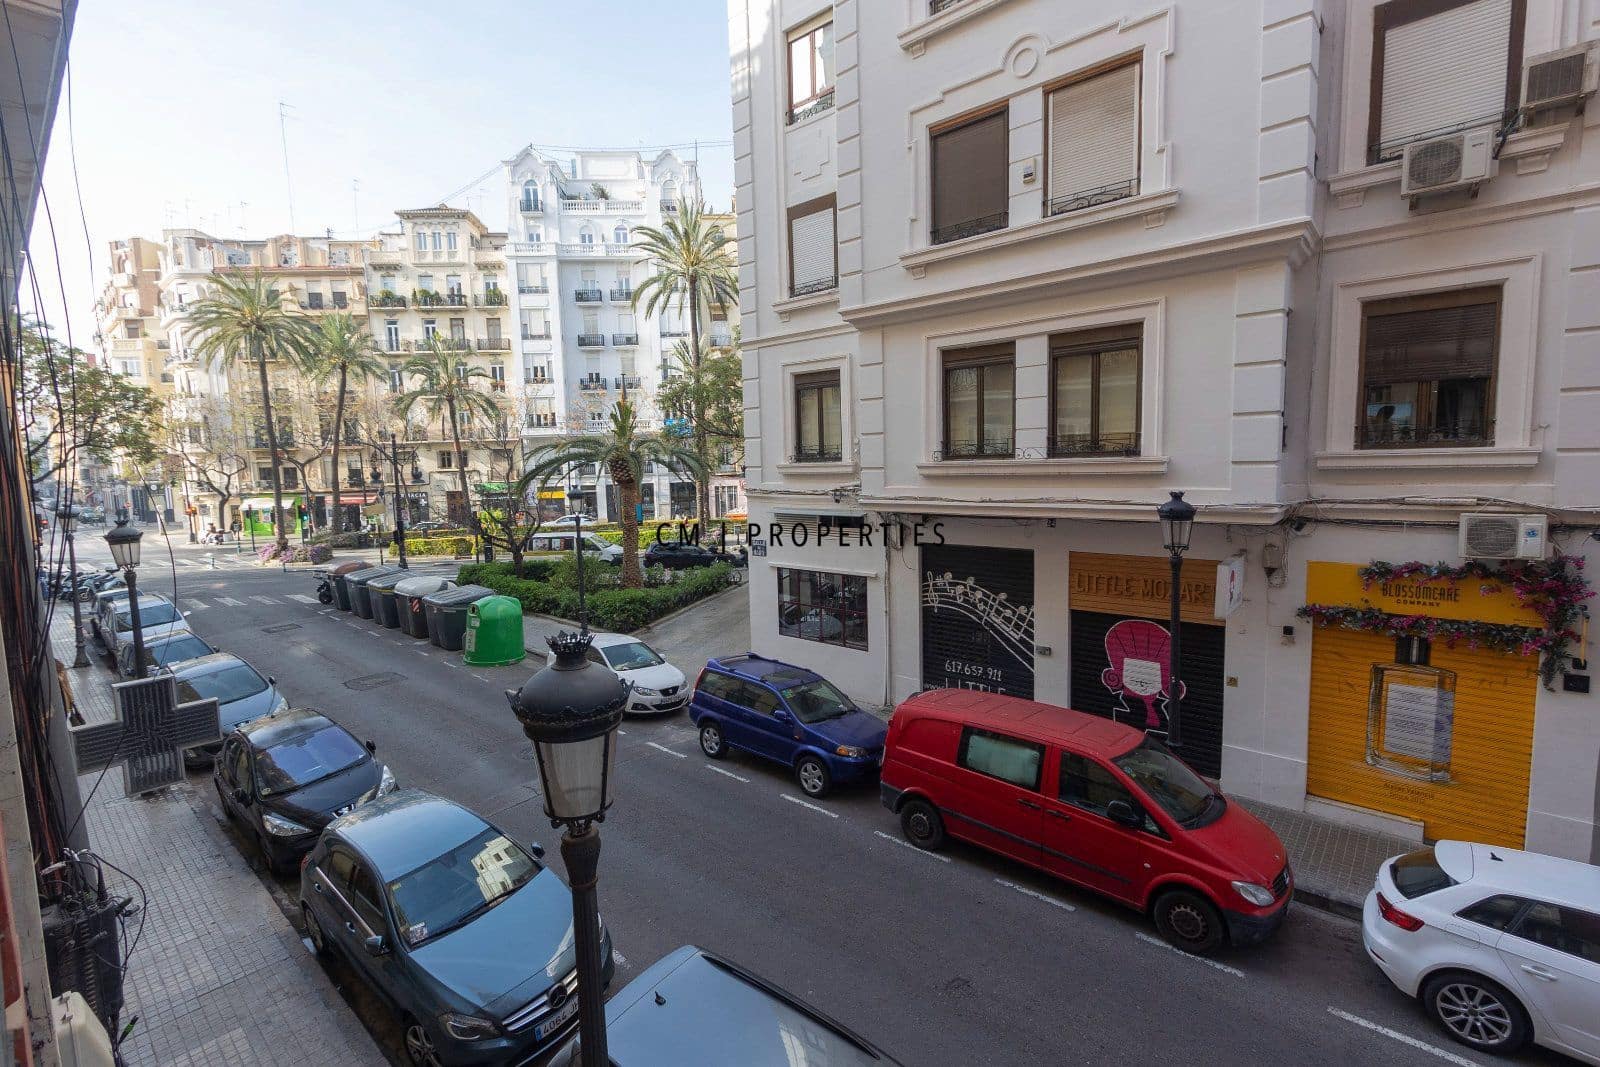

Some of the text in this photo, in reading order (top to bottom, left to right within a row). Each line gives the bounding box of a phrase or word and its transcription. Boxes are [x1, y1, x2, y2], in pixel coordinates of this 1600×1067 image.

[1075, 572, 1135, 596] LITTLE
[1382, 583, 1460, 602] BLOSSOMCARE
[1396, 598, 1441, 607] COMPANY
